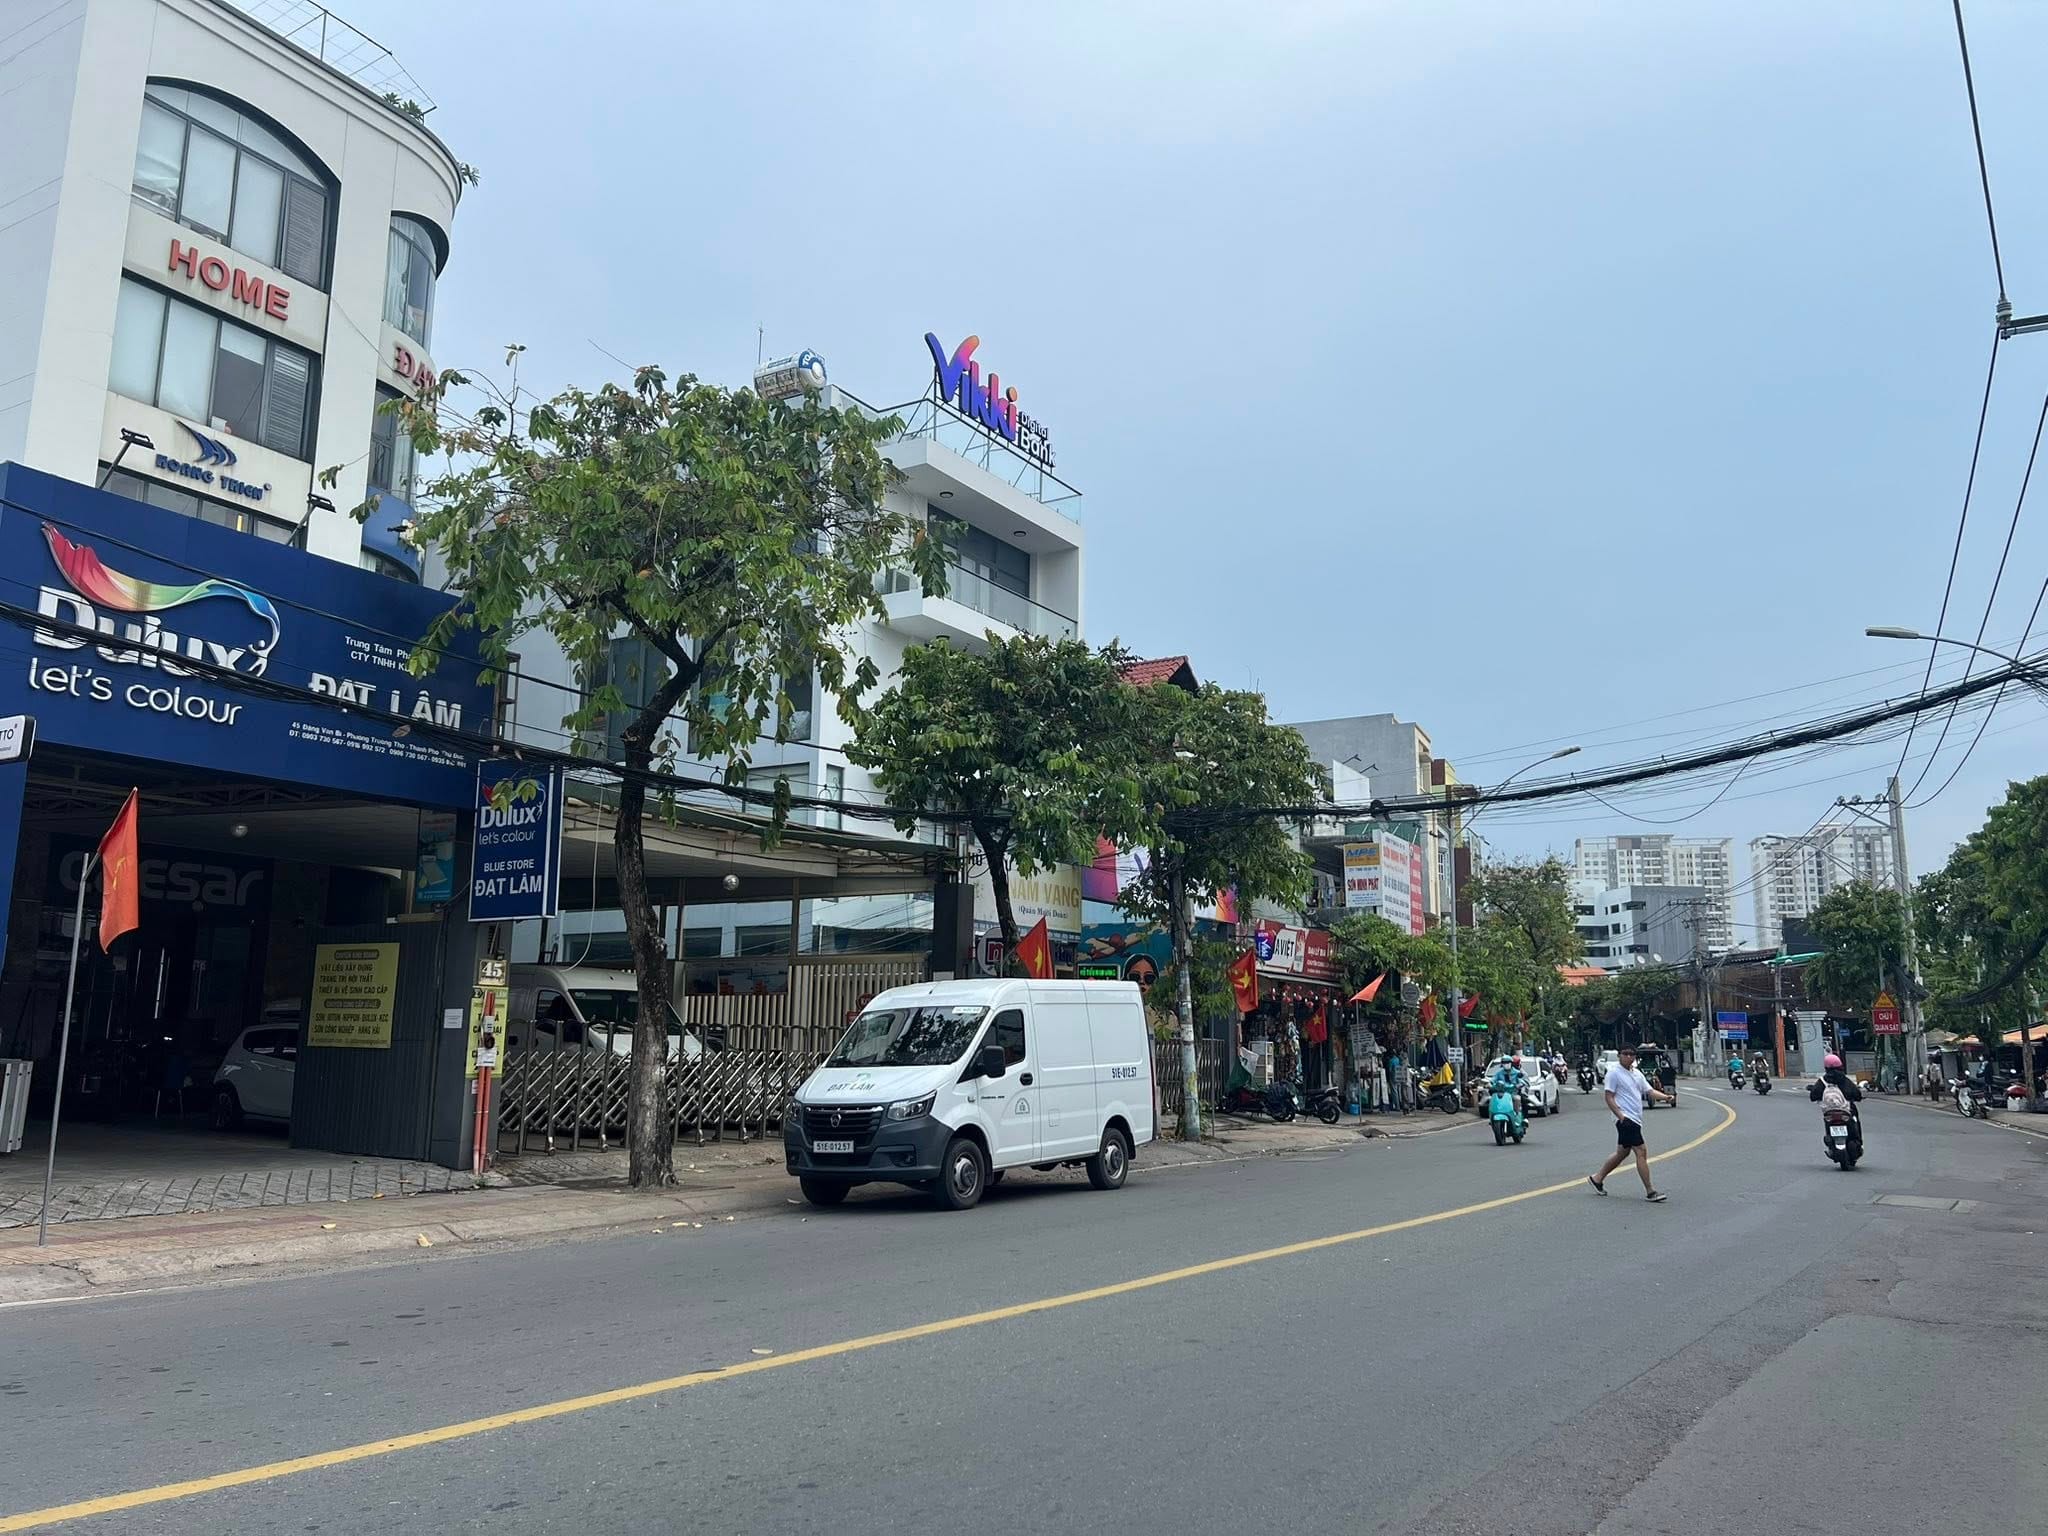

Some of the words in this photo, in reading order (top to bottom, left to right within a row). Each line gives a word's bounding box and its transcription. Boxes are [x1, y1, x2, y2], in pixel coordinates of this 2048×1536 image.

[168, 239, 290, 321] HOME
[924, 332, 1017, 442] Vikki
[1018, 411, 1049, 440] Digital
[1018, 427, 1056, 468] Bank
[344, 635, 371, 652] Trung
[350, 650, 370, 663] CTY
[372, 655, 396, 669] TNHH
[28, 656, 113, 701] let's
[125, 684, 243, 726] colour
[480, 805, 536, 829] Dulux
[479, 831, 500, 845] let's
[501, 830, 536, 844] colour
[484, 861, 506, 873] BLUE
[507, 859, 535, 871] STORE
[475, 877, 507, 898] ĐẠT
[509, 873, 543, 894] LÂM
[1044, 883, 1080, 908] VANG
[481, 962, 503, 978] 45
